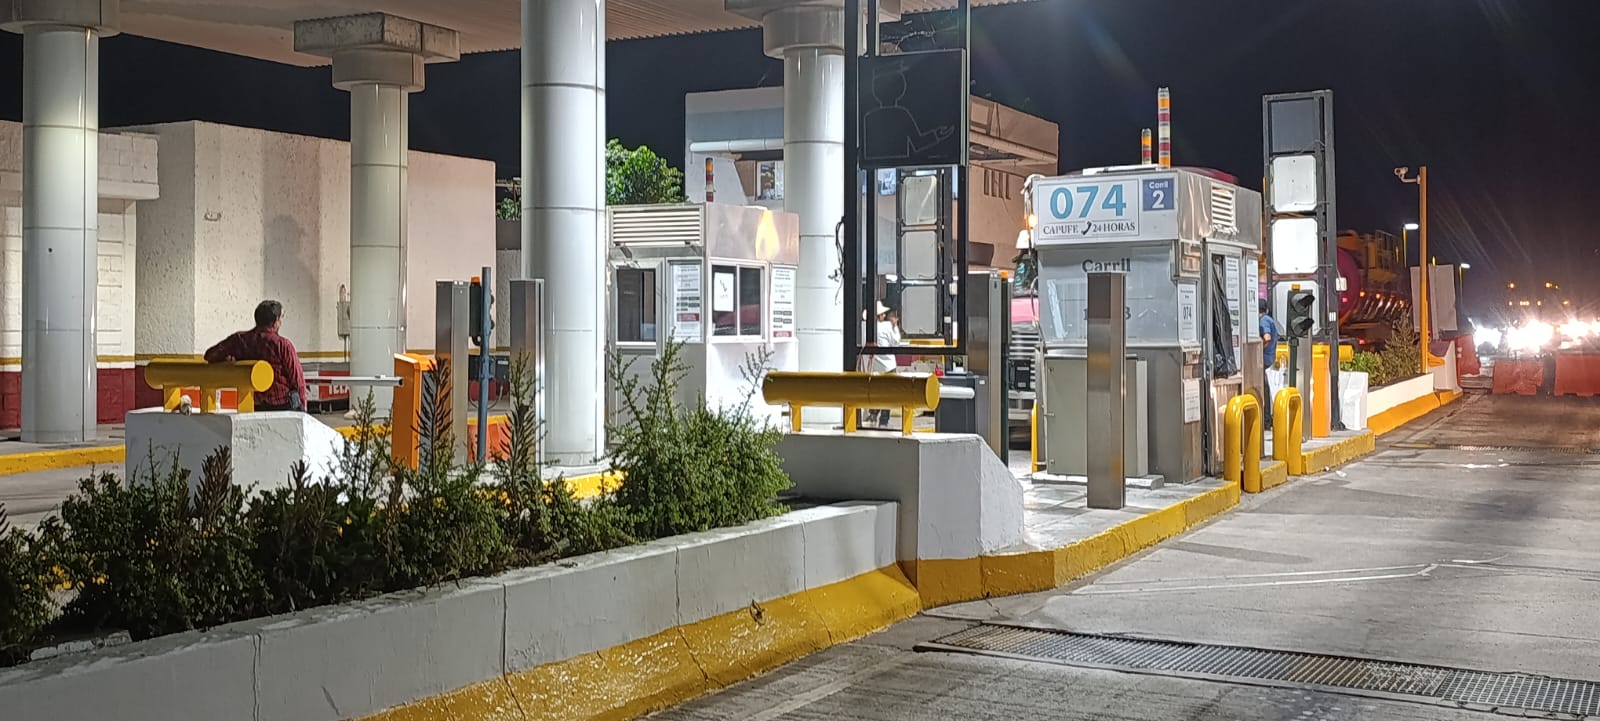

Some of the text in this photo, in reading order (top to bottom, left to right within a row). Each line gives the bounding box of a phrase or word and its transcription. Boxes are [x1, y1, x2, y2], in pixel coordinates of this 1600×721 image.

[1149, 181, 1168, 189] Carril
[1050, 184, 1127, 219] 074
[1152, 190, 1165, 209] 2
[1043, 222, 1136, 235] CAPUFE 24 HORAS
[1082, 258, 1131, 272] Carril
[1182, 306, 1192, 320] 074
